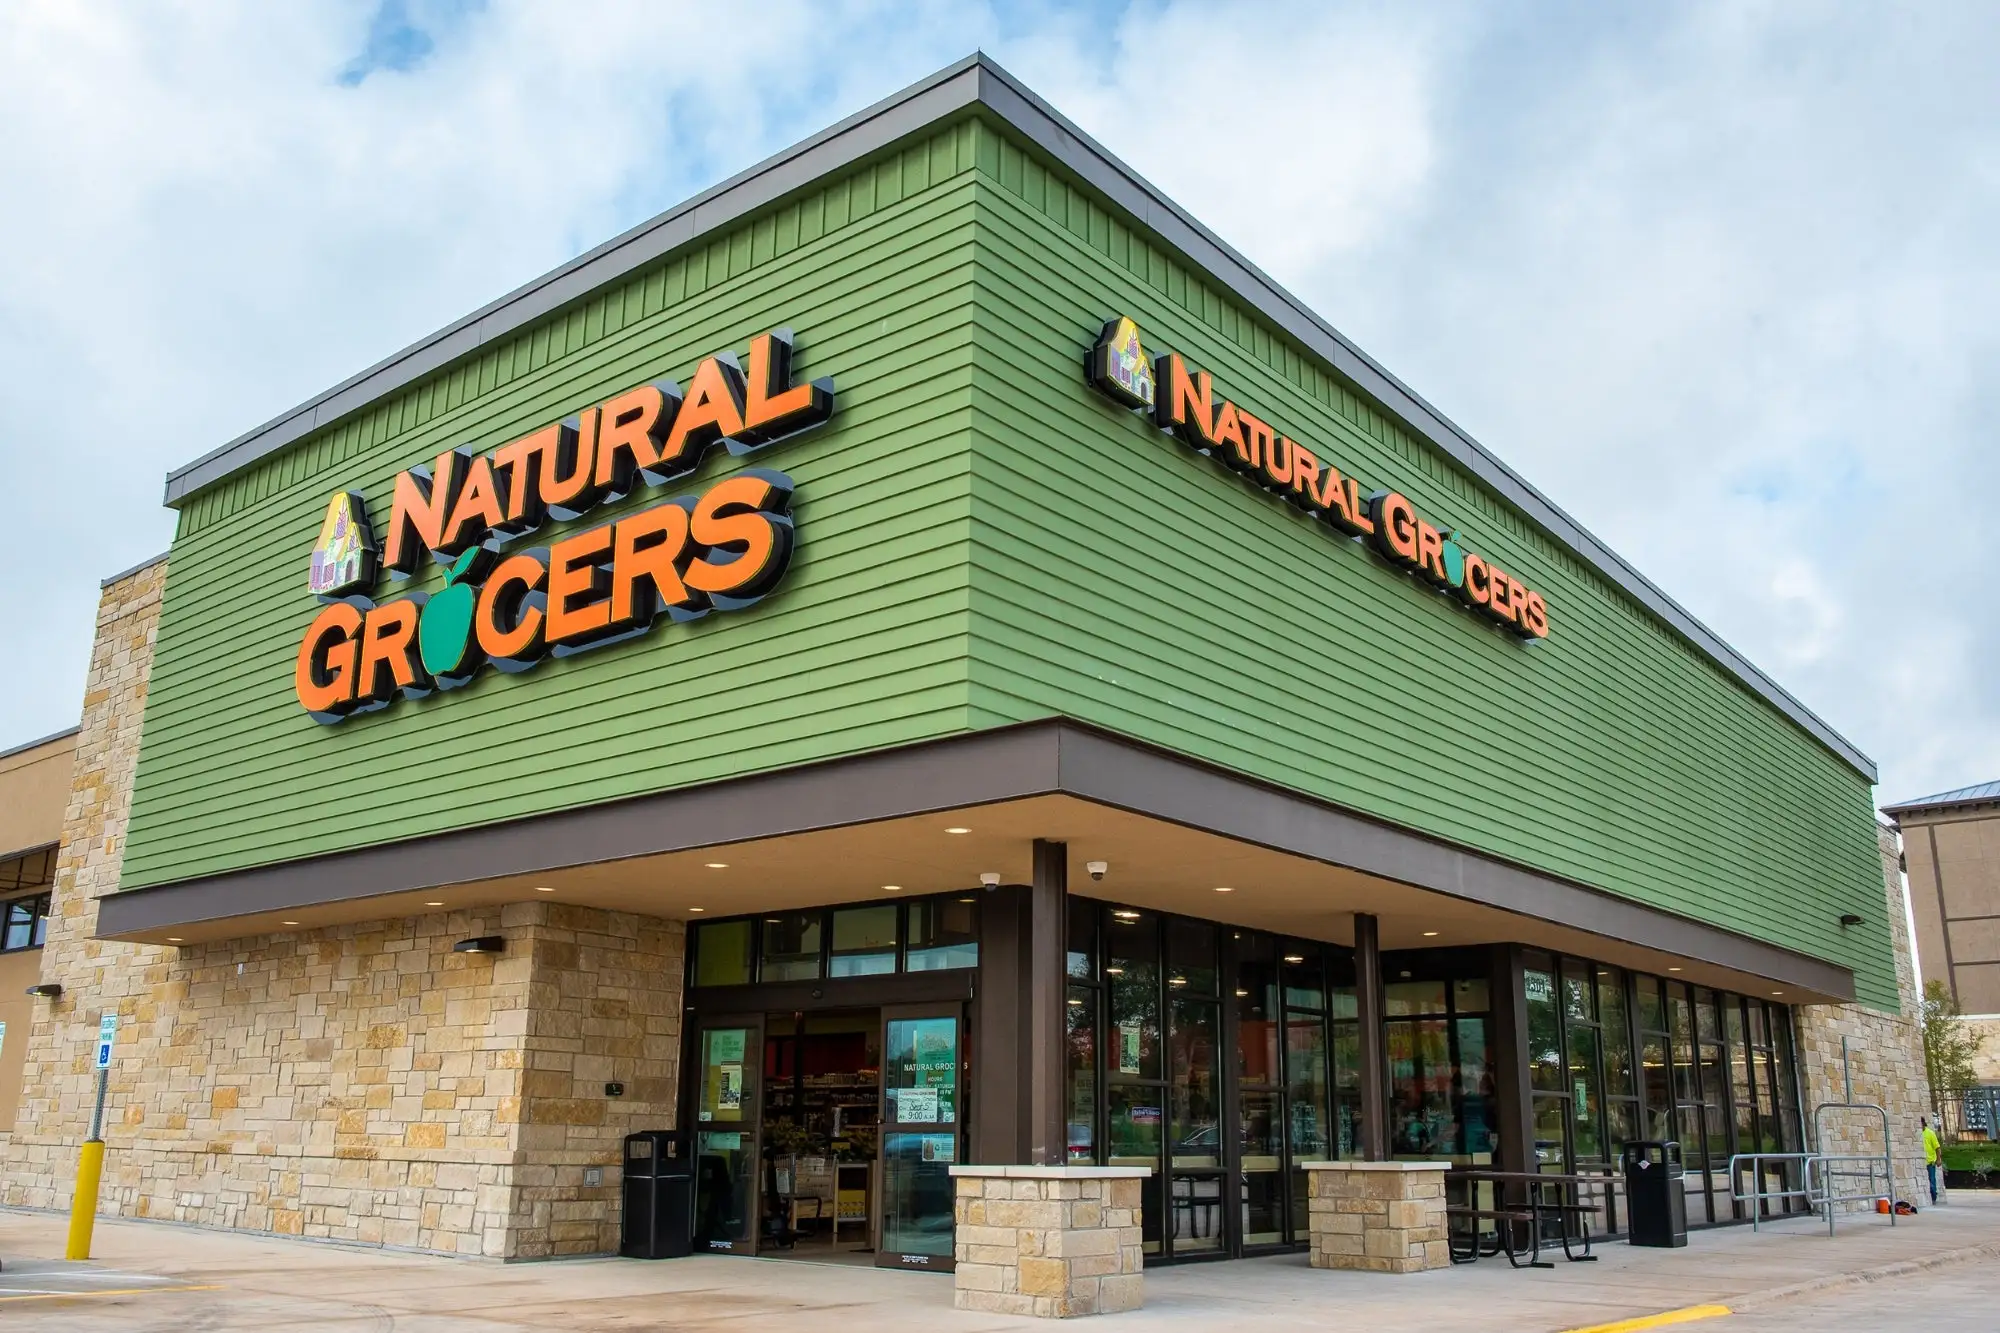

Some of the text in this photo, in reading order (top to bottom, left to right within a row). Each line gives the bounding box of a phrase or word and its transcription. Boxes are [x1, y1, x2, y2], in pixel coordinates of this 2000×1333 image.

[383, 333, 813, 569] NATURAL
[1171, 353, 1549, 638] NATURAL GROCERS
[296, 476, 775, 712] GROCERS
[904, 1062, 968, 1071] NATURAL GROCS
